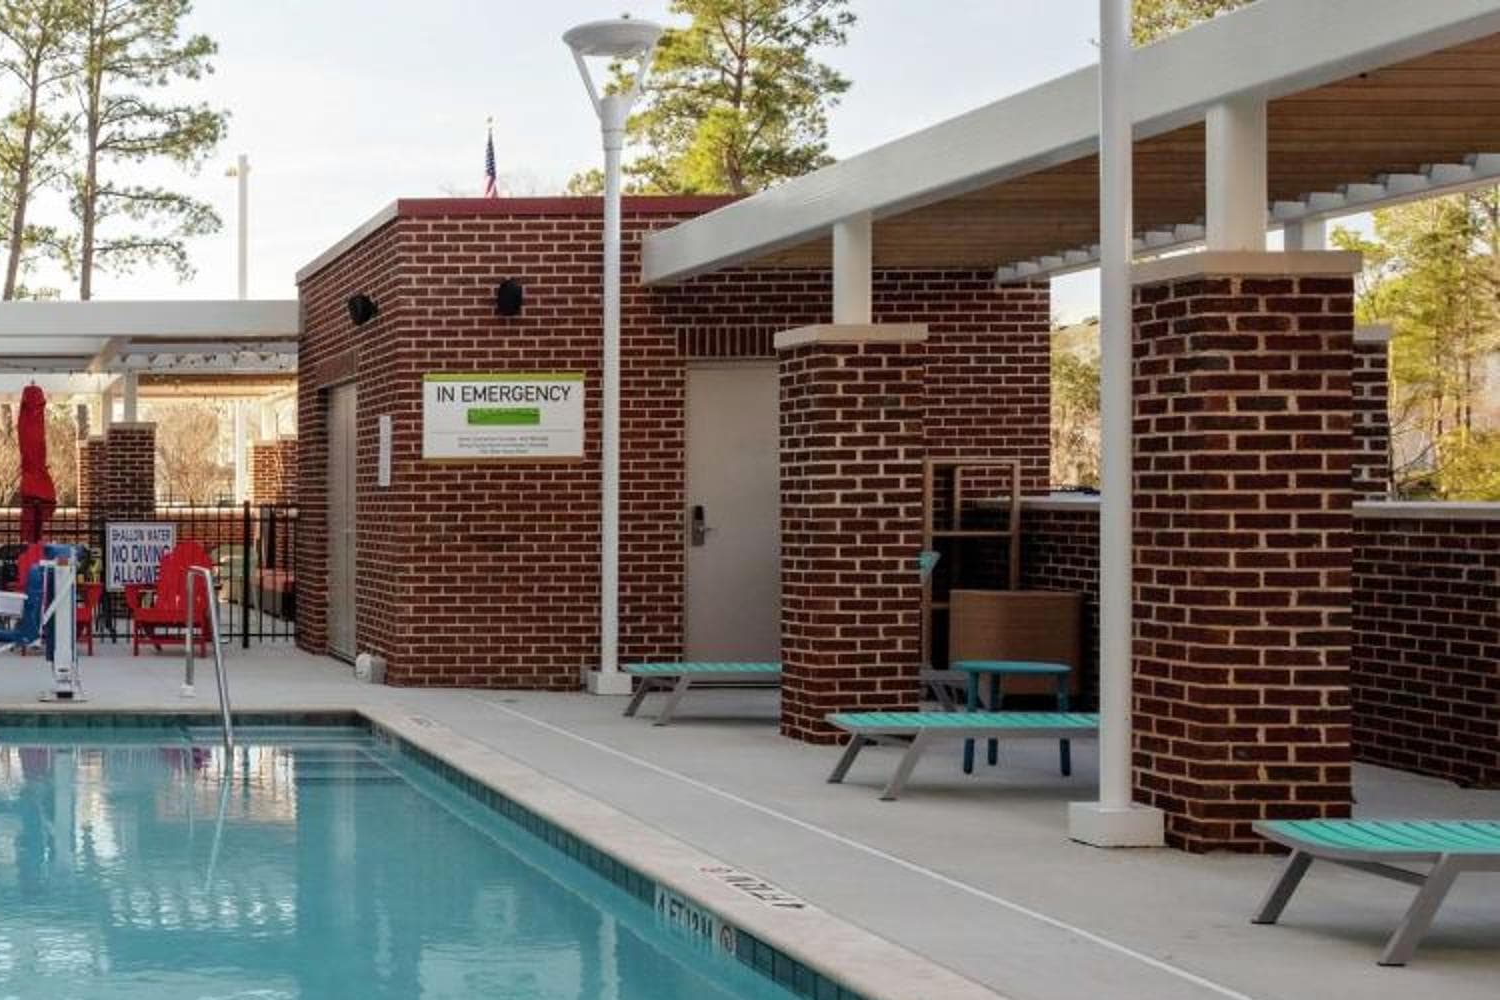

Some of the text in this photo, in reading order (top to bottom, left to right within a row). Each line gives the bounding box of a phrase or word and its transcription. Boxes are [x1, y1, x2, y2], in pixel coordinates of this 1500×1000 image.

[437, 386, 571, 402] IN EMERGENCY
[112, 544, 128, 562] NO
